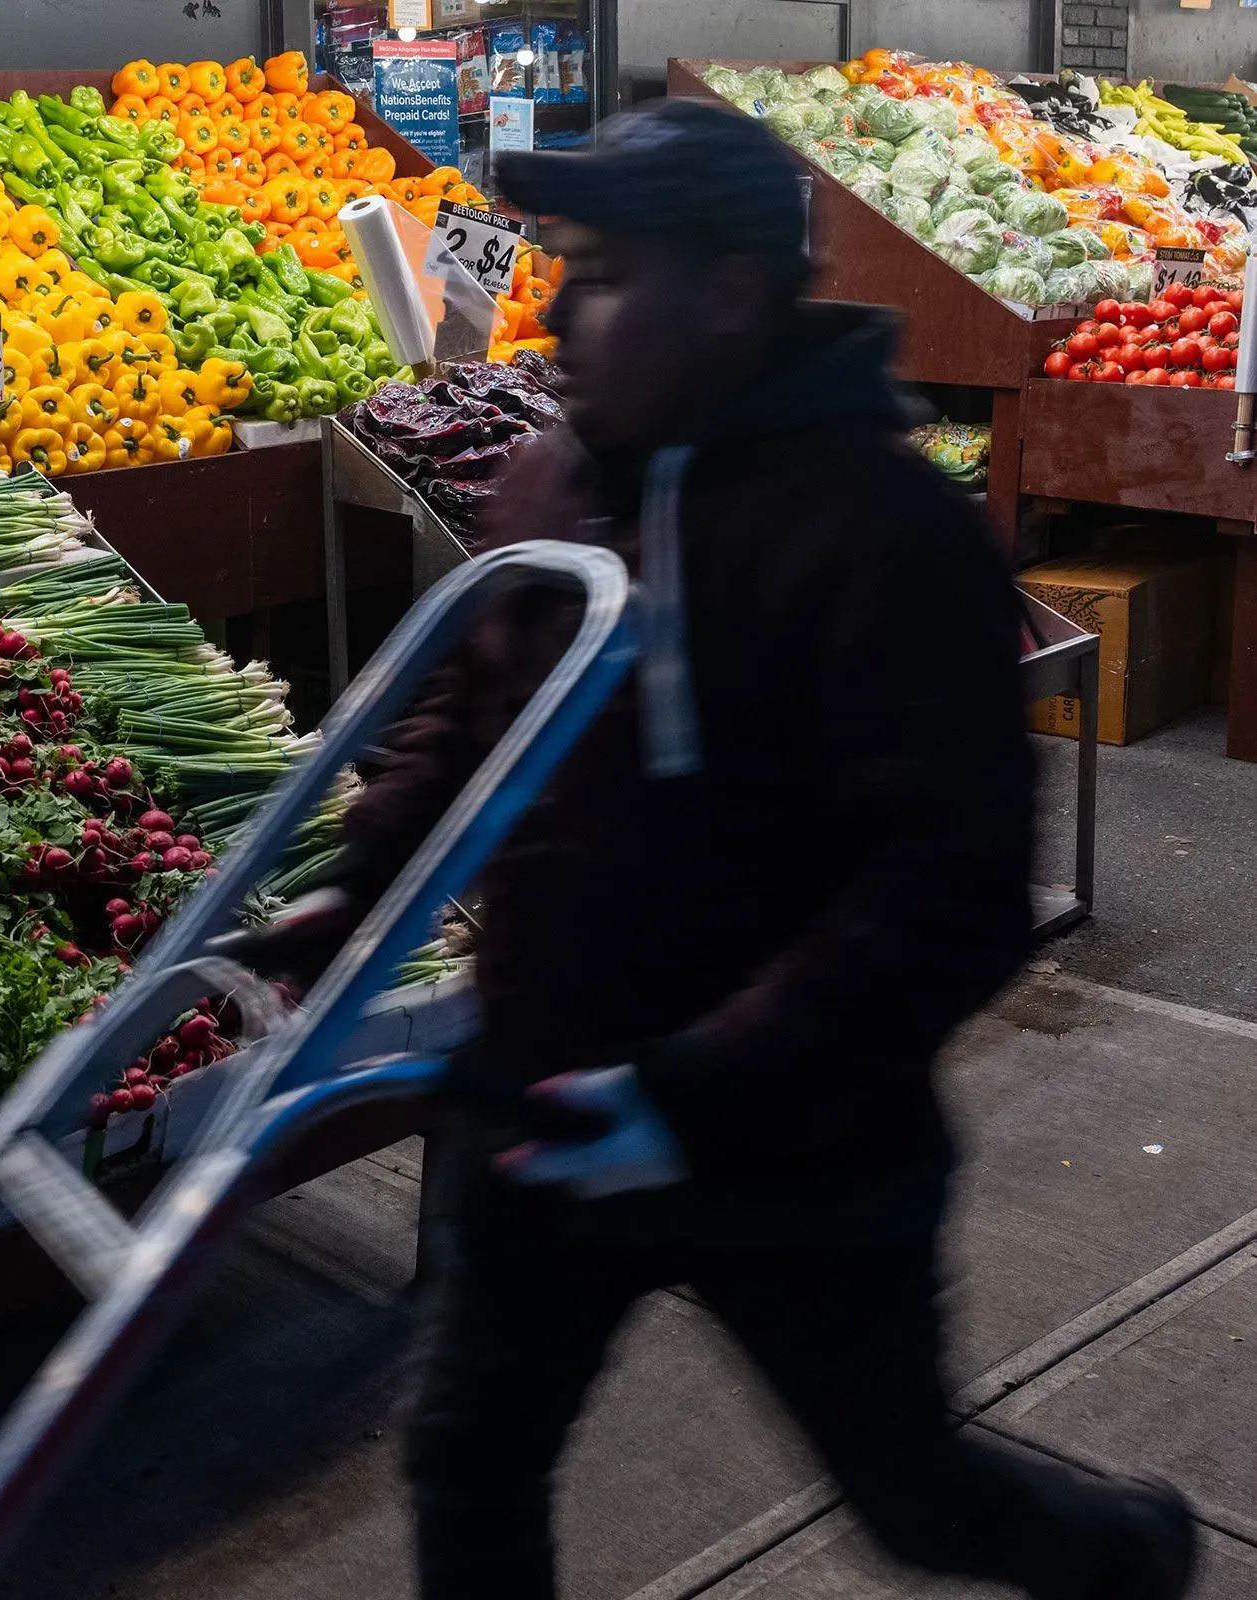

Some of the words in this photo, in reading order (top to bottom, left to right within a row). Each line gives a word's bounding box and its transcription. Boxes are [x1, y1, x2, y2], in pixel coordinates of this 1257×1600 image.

[391, 78, 406, 89] We
[408, 78, 441, 91] Accept
[380, 94, 451, 106] NationsBenefits
[384, 110, 419, 123] Prepaid
[421, 110, 450, 120] Cards!
[452, 203, 492, 223] BEETOLOGY
[492, 215, 510, 229] PACK
[436, 228, 467, 266] 2
[476, 234, 515, 282] $4
[497, 281, 510, 291] EACH
